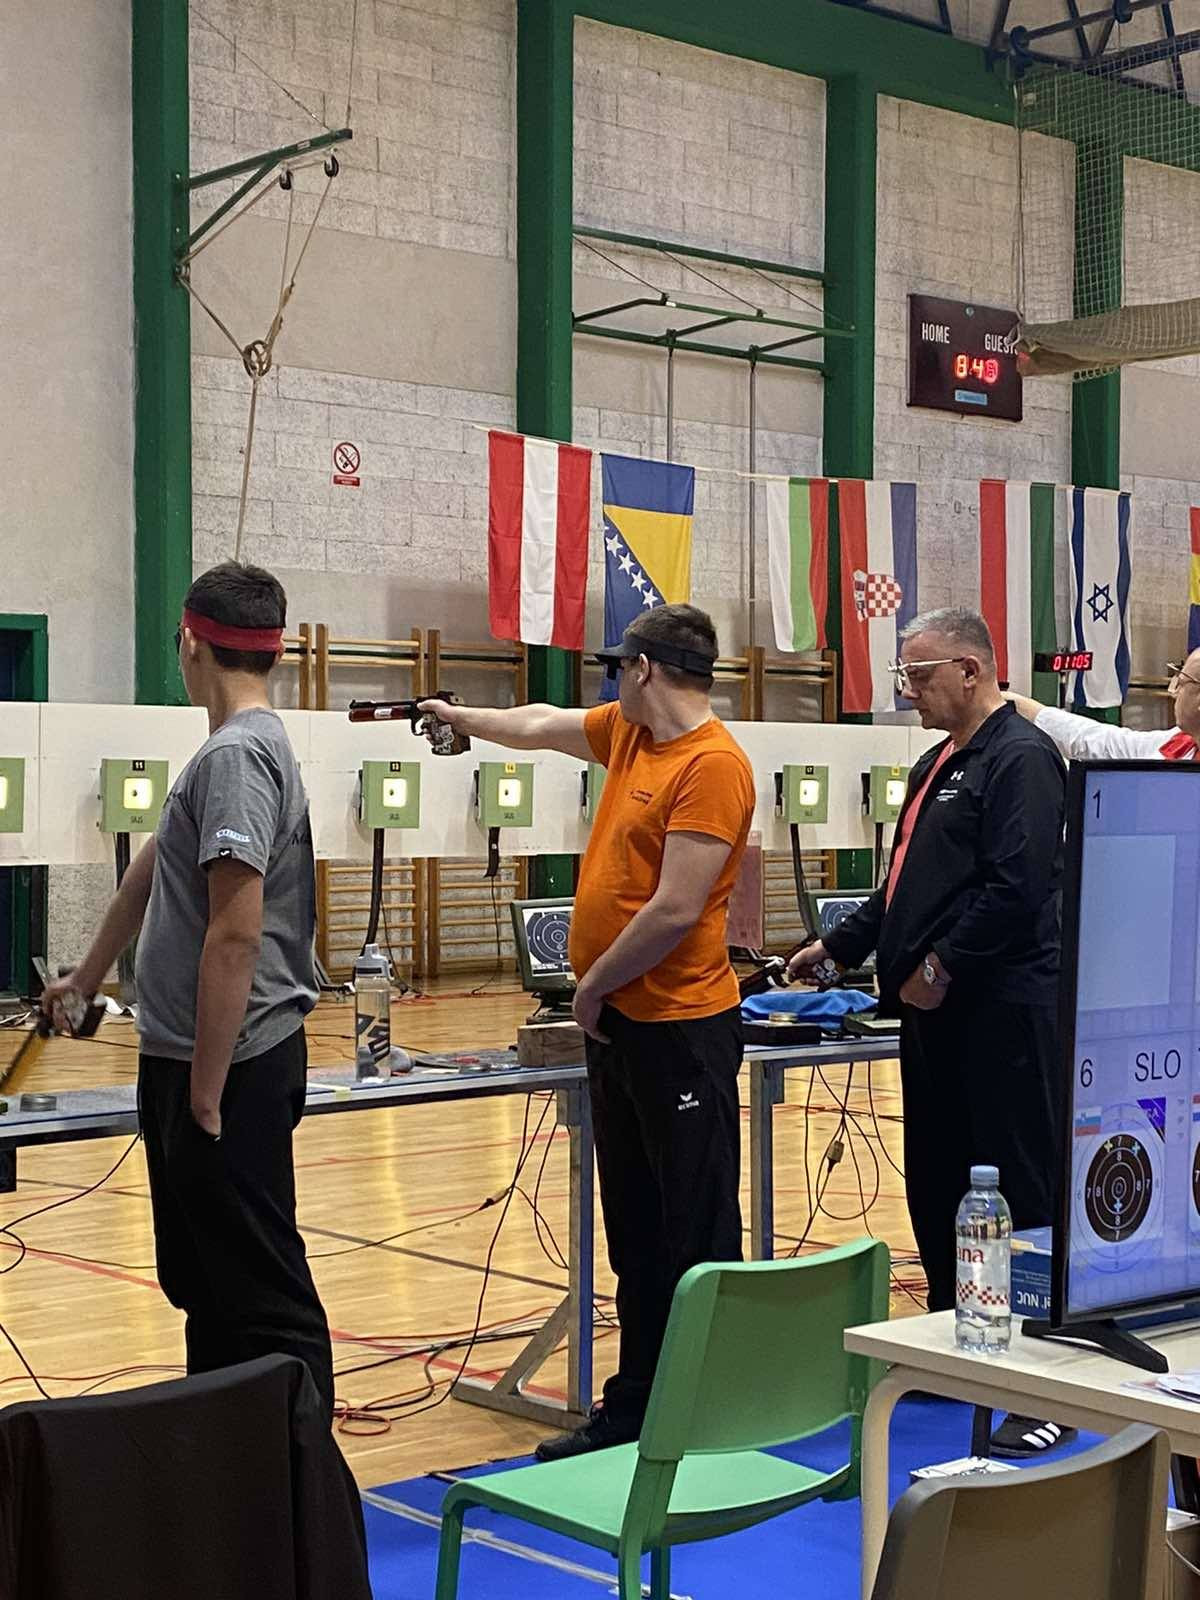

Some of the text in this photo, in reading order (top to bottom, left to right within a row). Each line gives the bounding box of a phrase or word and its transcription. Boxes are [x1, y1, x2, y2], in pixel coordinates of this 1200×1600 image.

[921, 322, 951, 344] HOME
[1092, 789, 1101, 819] 1
[1080, 1049, 1181, 1088] 6 SLO
[957, 1248, 985, 1264] na
[1016, 1290, 1039, 1308] NUC
